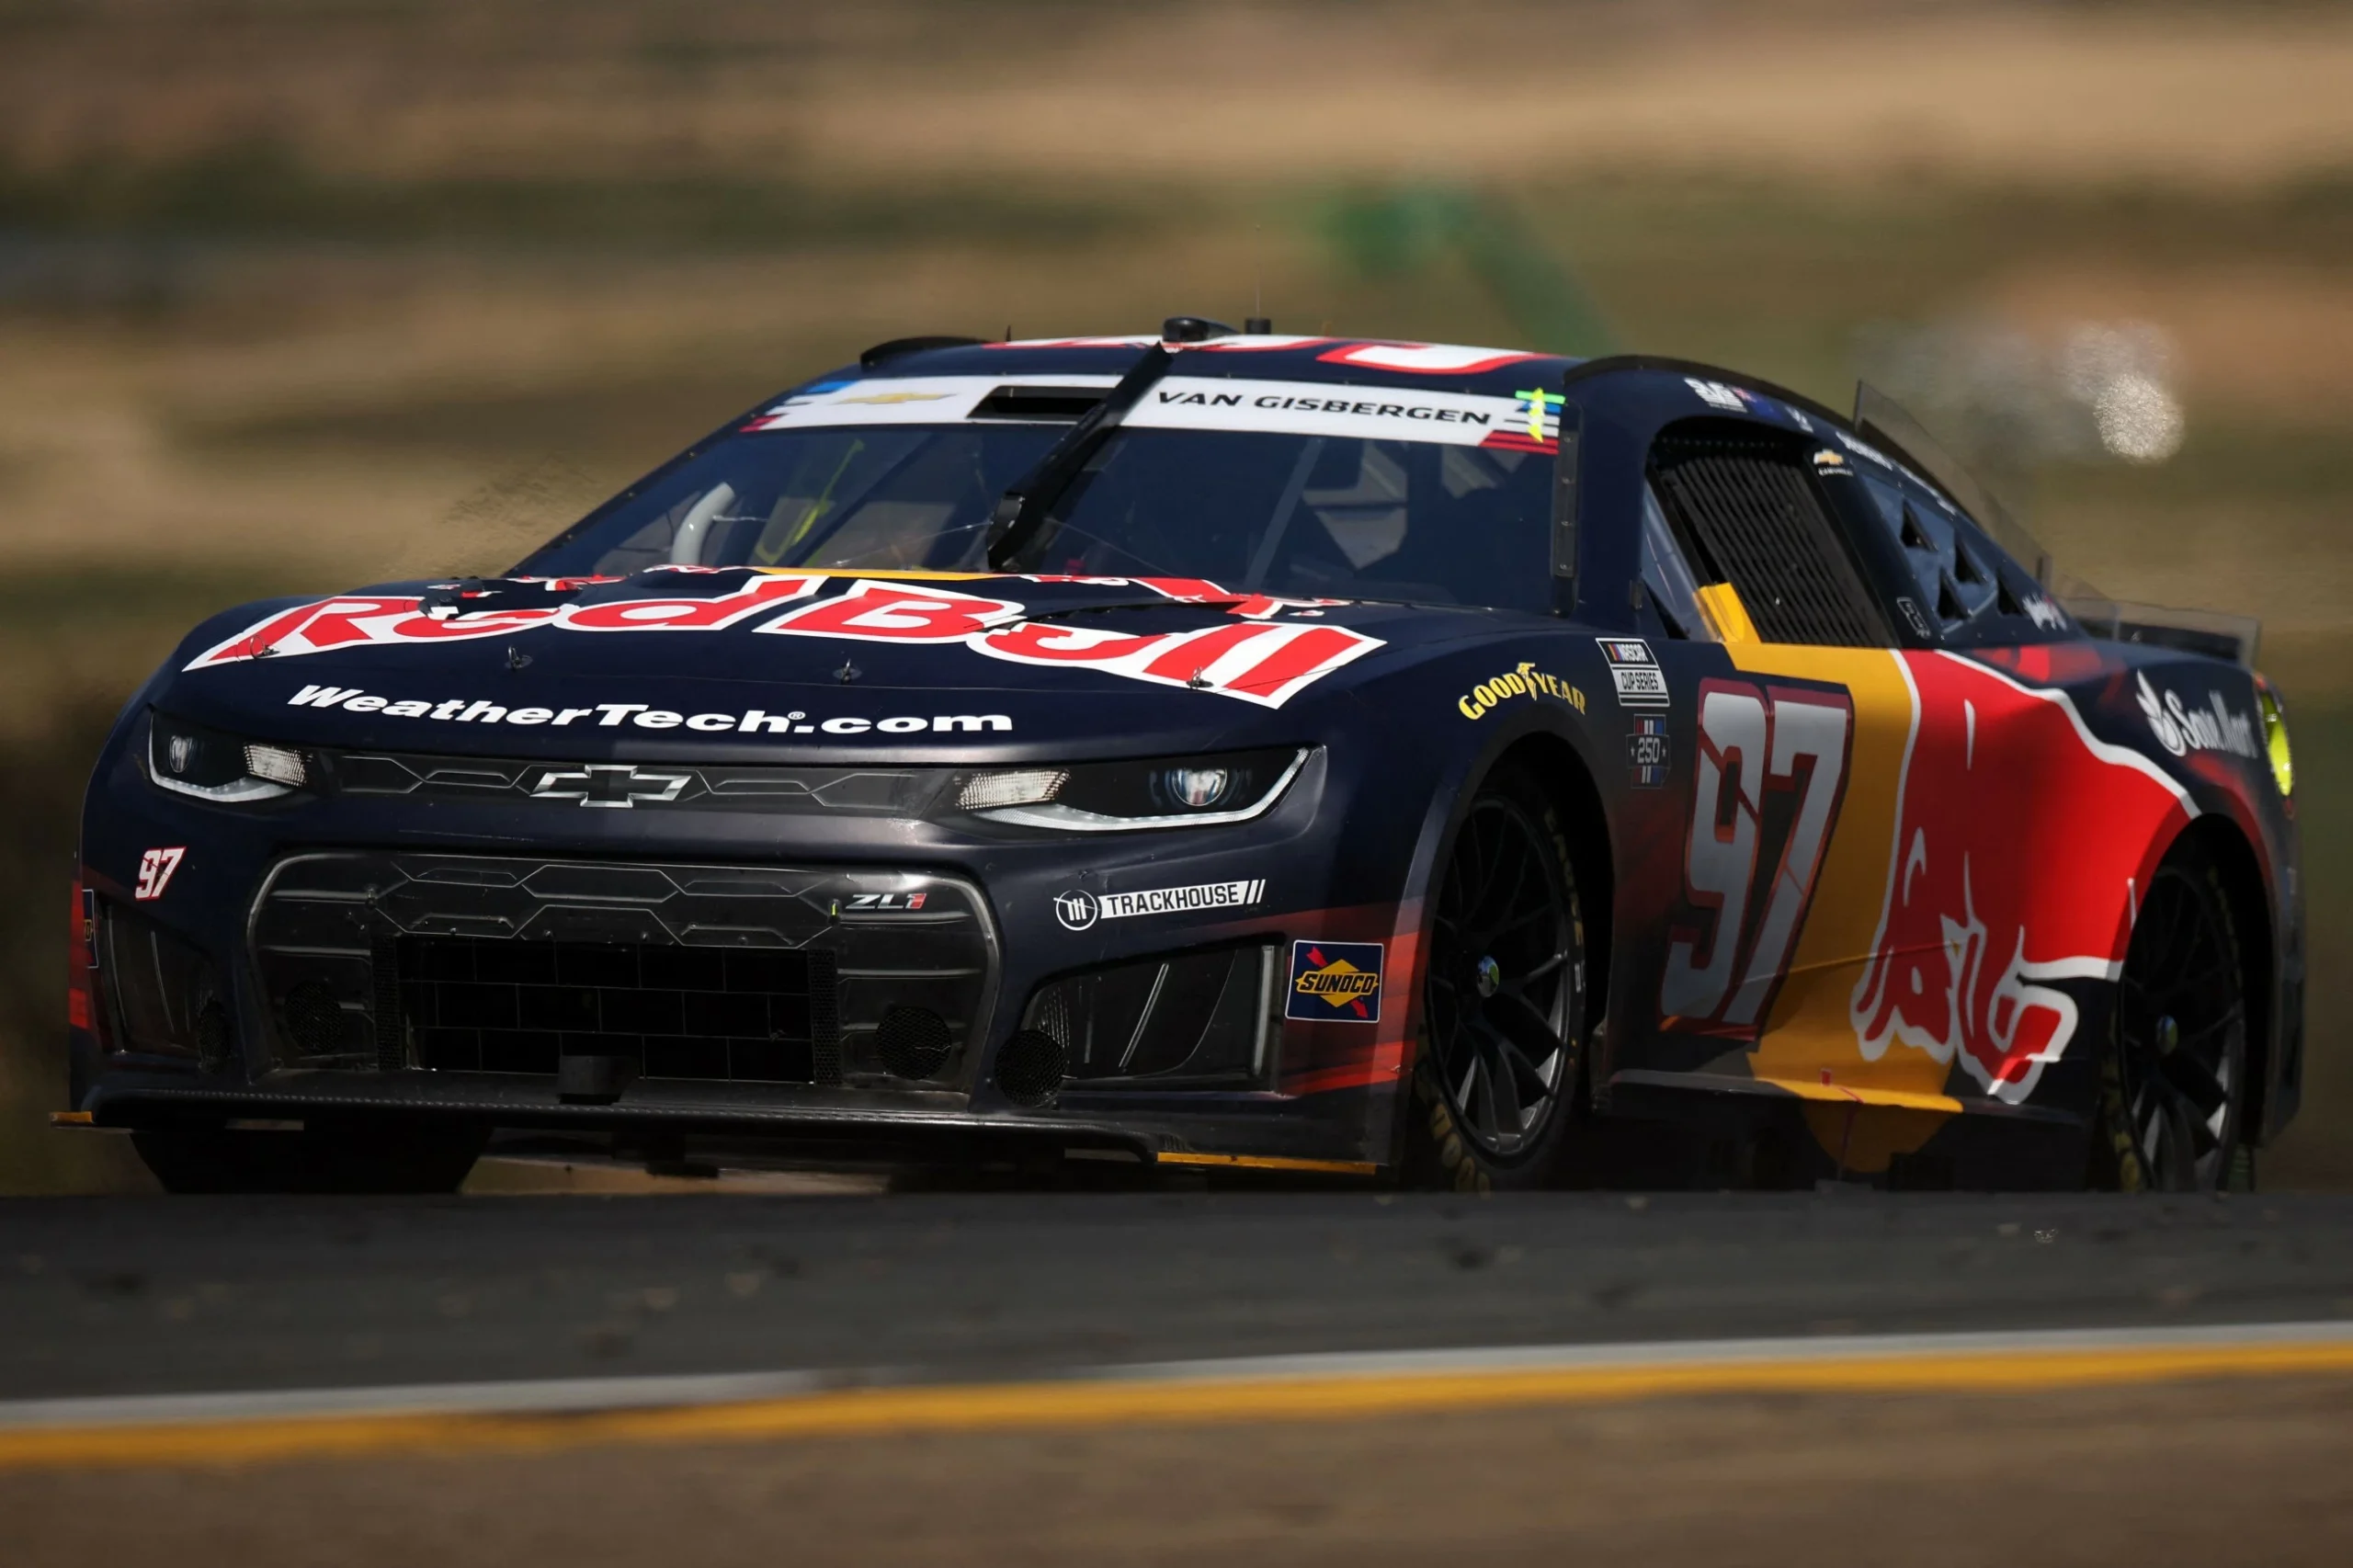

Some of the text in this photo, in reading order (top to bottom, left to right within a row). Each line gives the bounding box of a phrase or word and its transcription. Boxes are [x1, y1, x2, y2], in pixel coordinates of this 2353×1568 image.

[1156, 390, 1492, 426] VAN GISBERGEN
[1458, 670, 1586, 720] GOODYEAR
[1620, 672, 1659, 691] CUP SERIES
[1637, 737, 1660, 764] 250
[1661, 680, 1851, 1033] 97
[135, 846, 186, 901] 97
[846, 892, 927, 909] ZL1
[1107, 883, 1240, 916] TRACKHOUSE
[1299, 972, 1376, 994] SUNOCO
